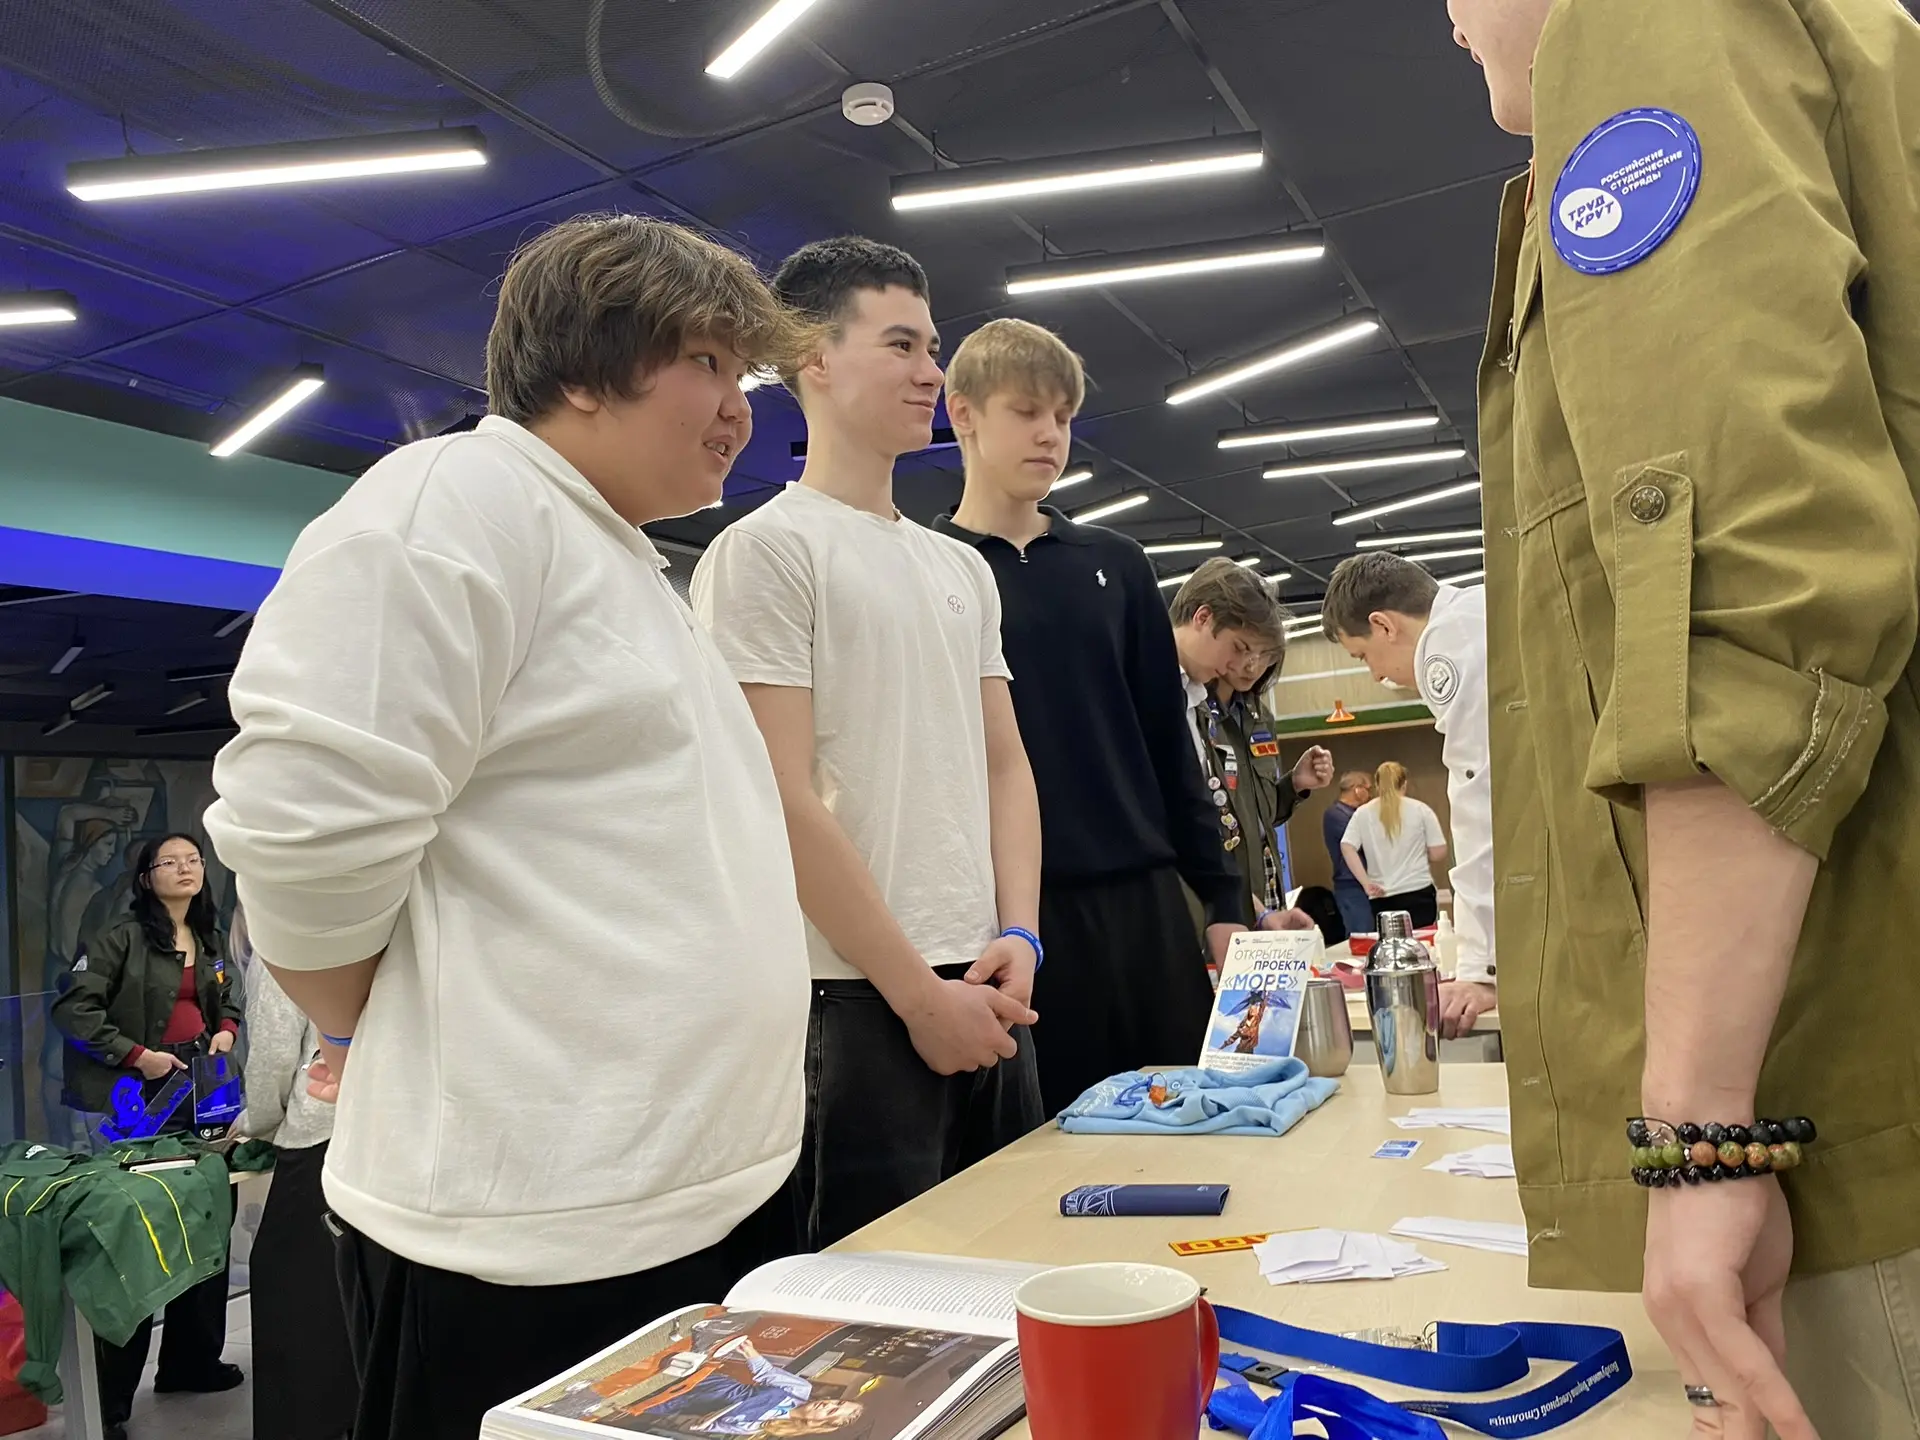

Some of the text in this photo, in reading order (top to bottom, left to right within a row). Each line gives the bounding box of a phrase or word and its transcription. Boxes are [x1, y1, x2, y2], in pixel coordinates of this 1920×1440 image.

[1600, 149, 1664, 186] РОССИЙСКИЕ
[1610, 150, 1683, 191] СТУДЕНЧЕСКИЕ
[1621, 171, 1661, 195] ОТРЯДЫ
[1568, 195, 1606, 221] ТРУД
[1574, 201, 1615, 231] КРУТ
[1234, 948, 1294, 961] ОТКРЫТИЕ
[1253, 960, 1307, 971] ПРОЕКТА
[1541, 1391, 1574, 1416] Северной
[1489, 1409, 1540, 1427] Столицы
